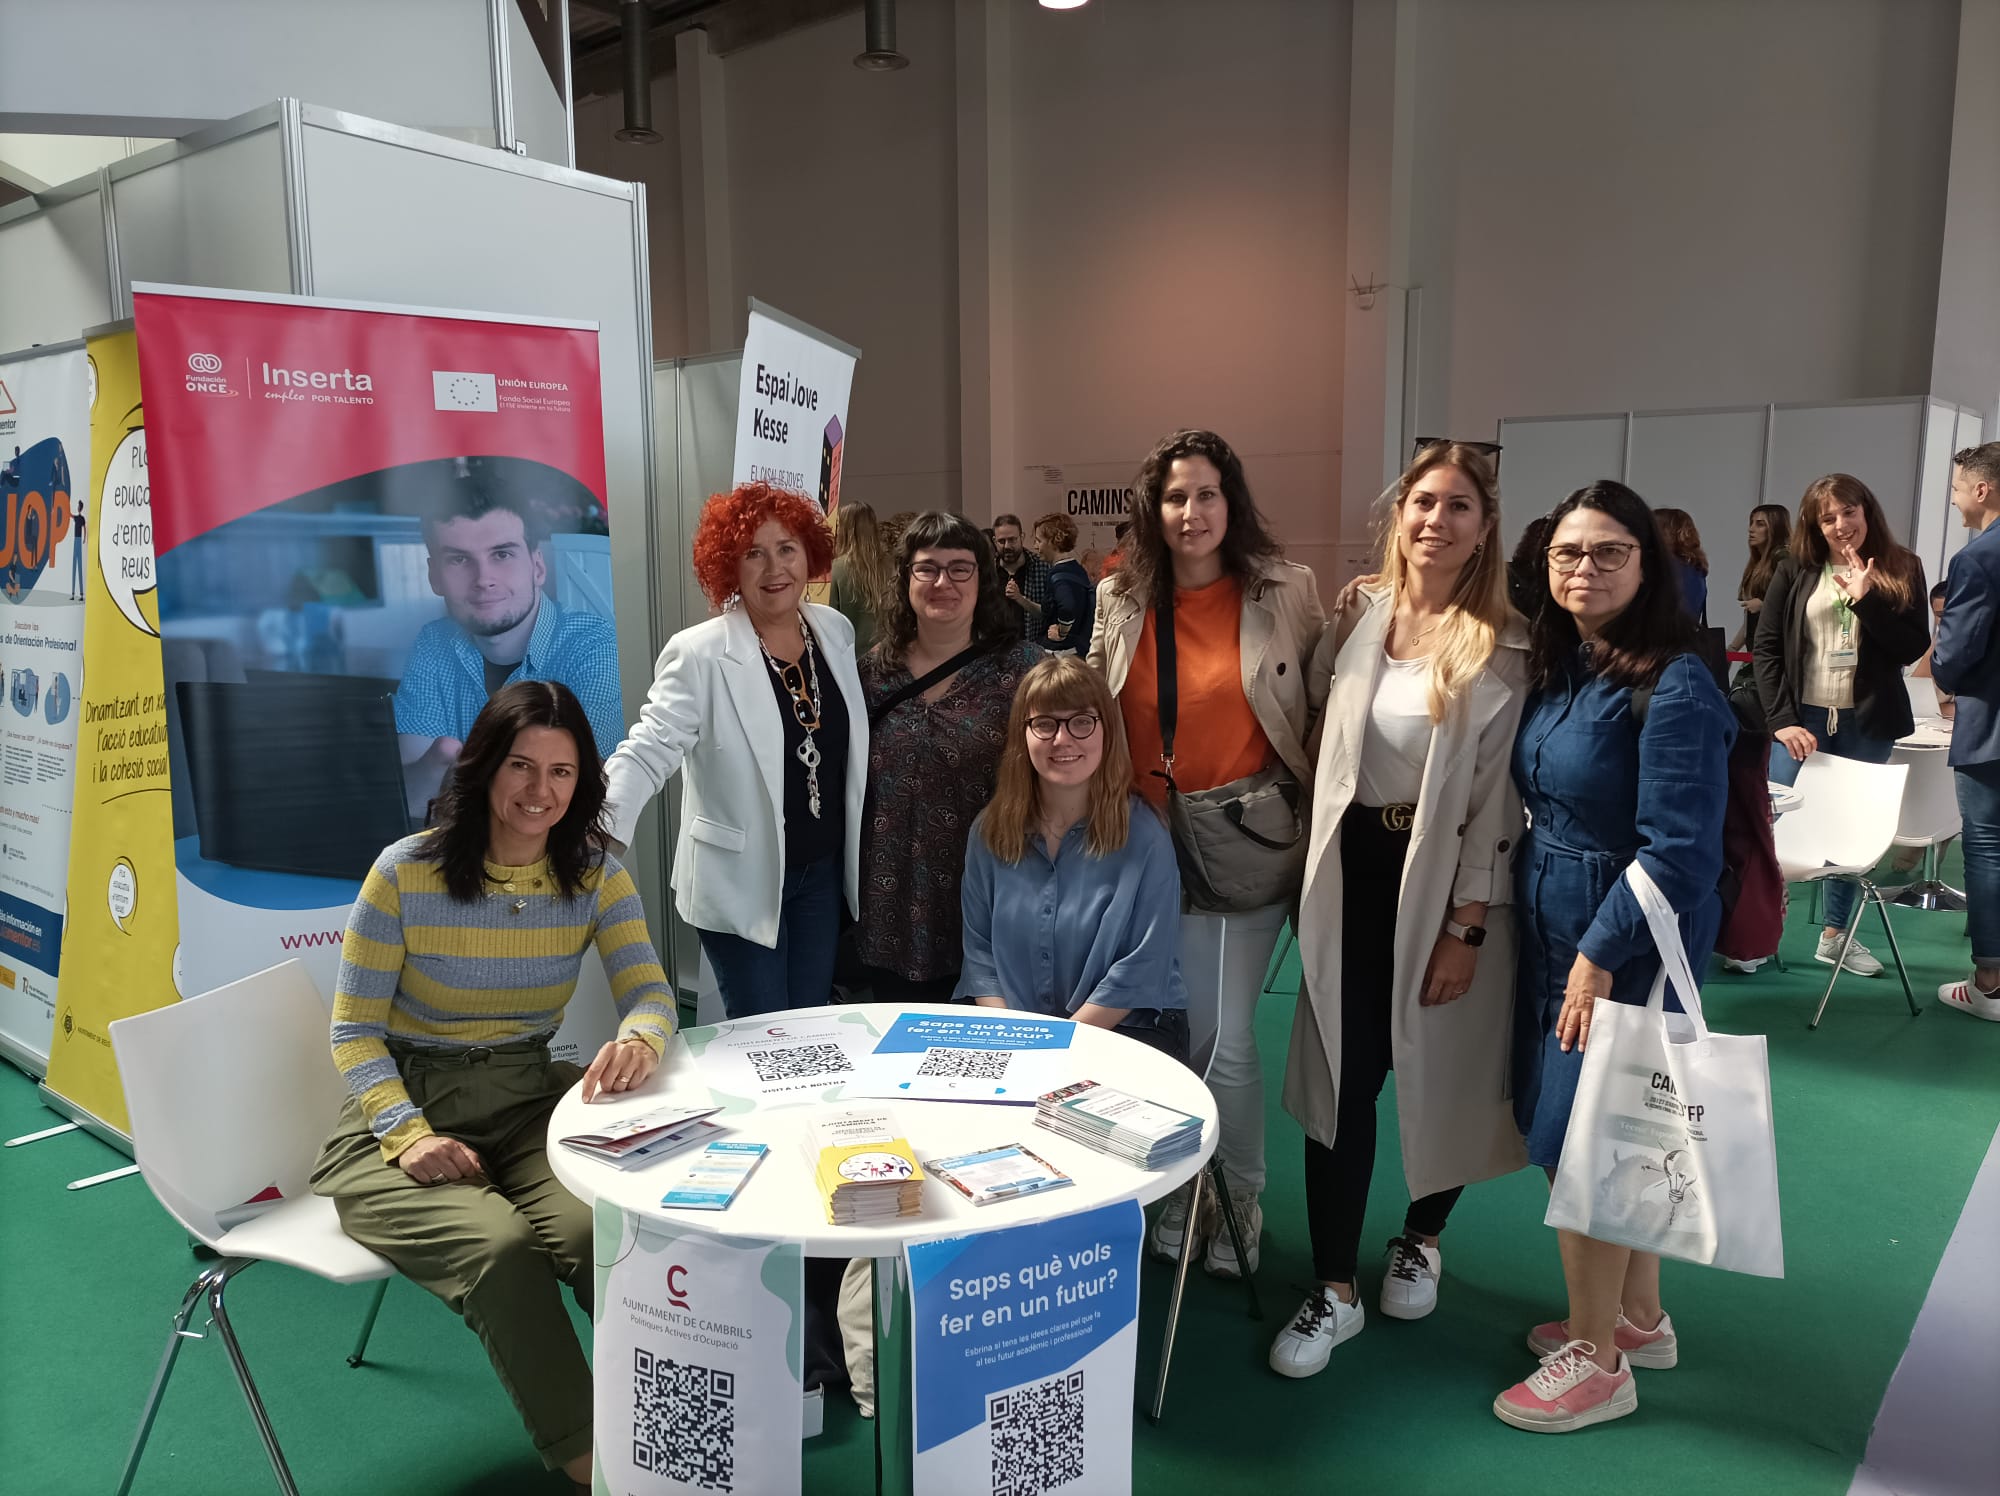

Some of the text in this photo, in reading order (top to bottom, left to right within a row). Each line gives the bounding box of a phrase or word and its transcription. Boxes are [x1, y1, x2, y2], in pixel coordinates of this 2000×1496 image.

[185, 374, 227, 383] Fundación
[185, 382, 228, 394] ONCE
[262, 361, 373, 392] Inserta
[497, 378, 569, 391] UNIÓN EUROPEA
[755, 363, 818, 411] Espai Jove
[264, 389, 374, 405] empleo POR TALENTO
[499, 395, 571, 407] Fondo Social Europeo
[753, 407, 789, 444] Kesse
[1067, 488, 1134, 515] CAMINS
[112, 522, 153, 547] d'ento
[5, 633, 12, 644] de
[13, 633, 43, 648] Orientación
[45, 637, 77, 651] Profesional
[85, 690, 140, 723] Dinamitzant
[142, 695, 154, 714] en
[97, 727, 126, 752] l'acció
[129, 720, 168, 747] educativa
[92, 763, 96, 783] i
[99, 760, 107, 783] la
[110, 756, 144, 781] cohesió
[147, 751, 169, 777] social
[907, 1026, 933, 1034] fer
[997, 1031, 1055, 1040] futur?
[918, 1020, 1050, 1033] Saps què vols
[551, 1043, 578, 1052] UROPEA
[761, 1085, 792, 1094] VISITA
[810, 1080, 847, 1088] NOSTRA
[949, 1242, 1112, 1301] Saps què vols
[939, 1267, 1119, 1337] fer en un futur?
[622, 1296, 753, 1340] AJUNTAMENT DE CAMBRILS
[664, 1325, 691, 1340] Actives
[693, 1334, 738, 1350] d'Ocupació
[964, 1310, 1101, 1357] Esbrina si tens les idees clares pel que fa
[975, 1357, 983, 1367] al
[984, 1355, 996, 1365] teu
[998, 1350, 1015, 1361] futur
[1016, 1340, 1049, 1356] acadèmic
[1053, 1325, 1093, 1345] professional
